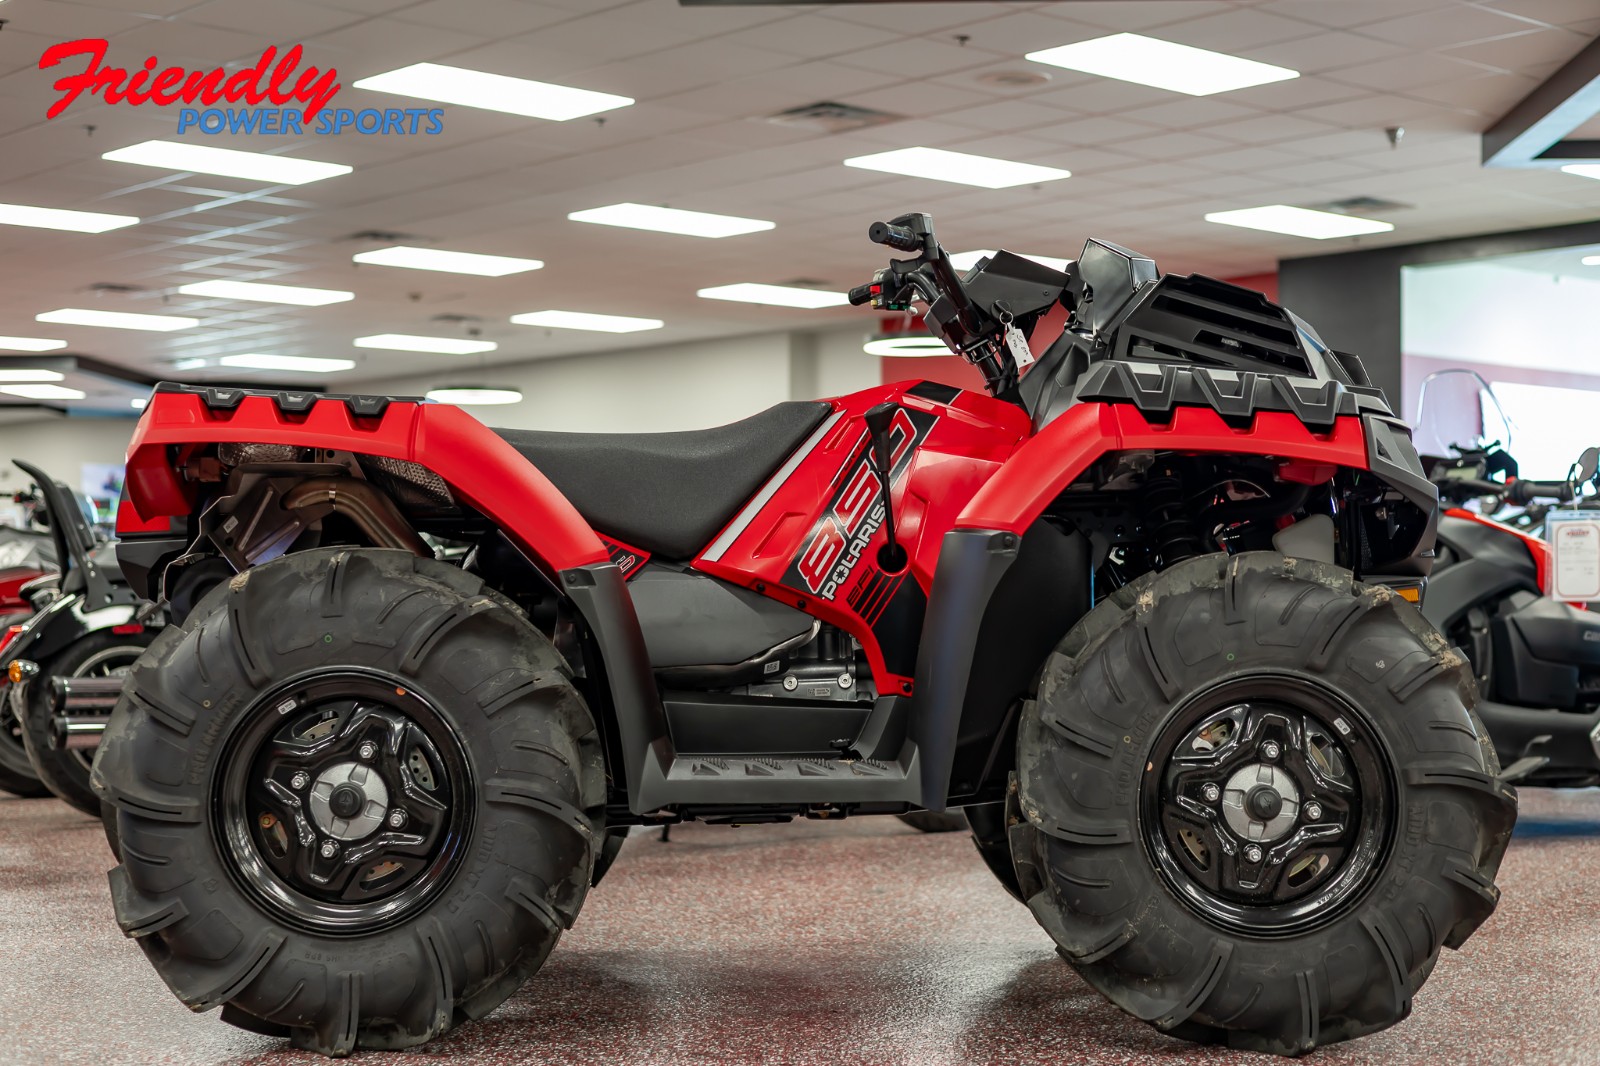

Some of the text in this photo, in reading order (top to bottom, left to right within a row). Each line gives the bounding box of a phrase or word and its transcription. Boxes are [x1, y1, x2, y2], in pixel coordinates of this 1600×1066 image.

[797, 407, 918, 594] 850
[822, 504, 886, 600] POLARIS
[846, 564, 875, 607] EFI
